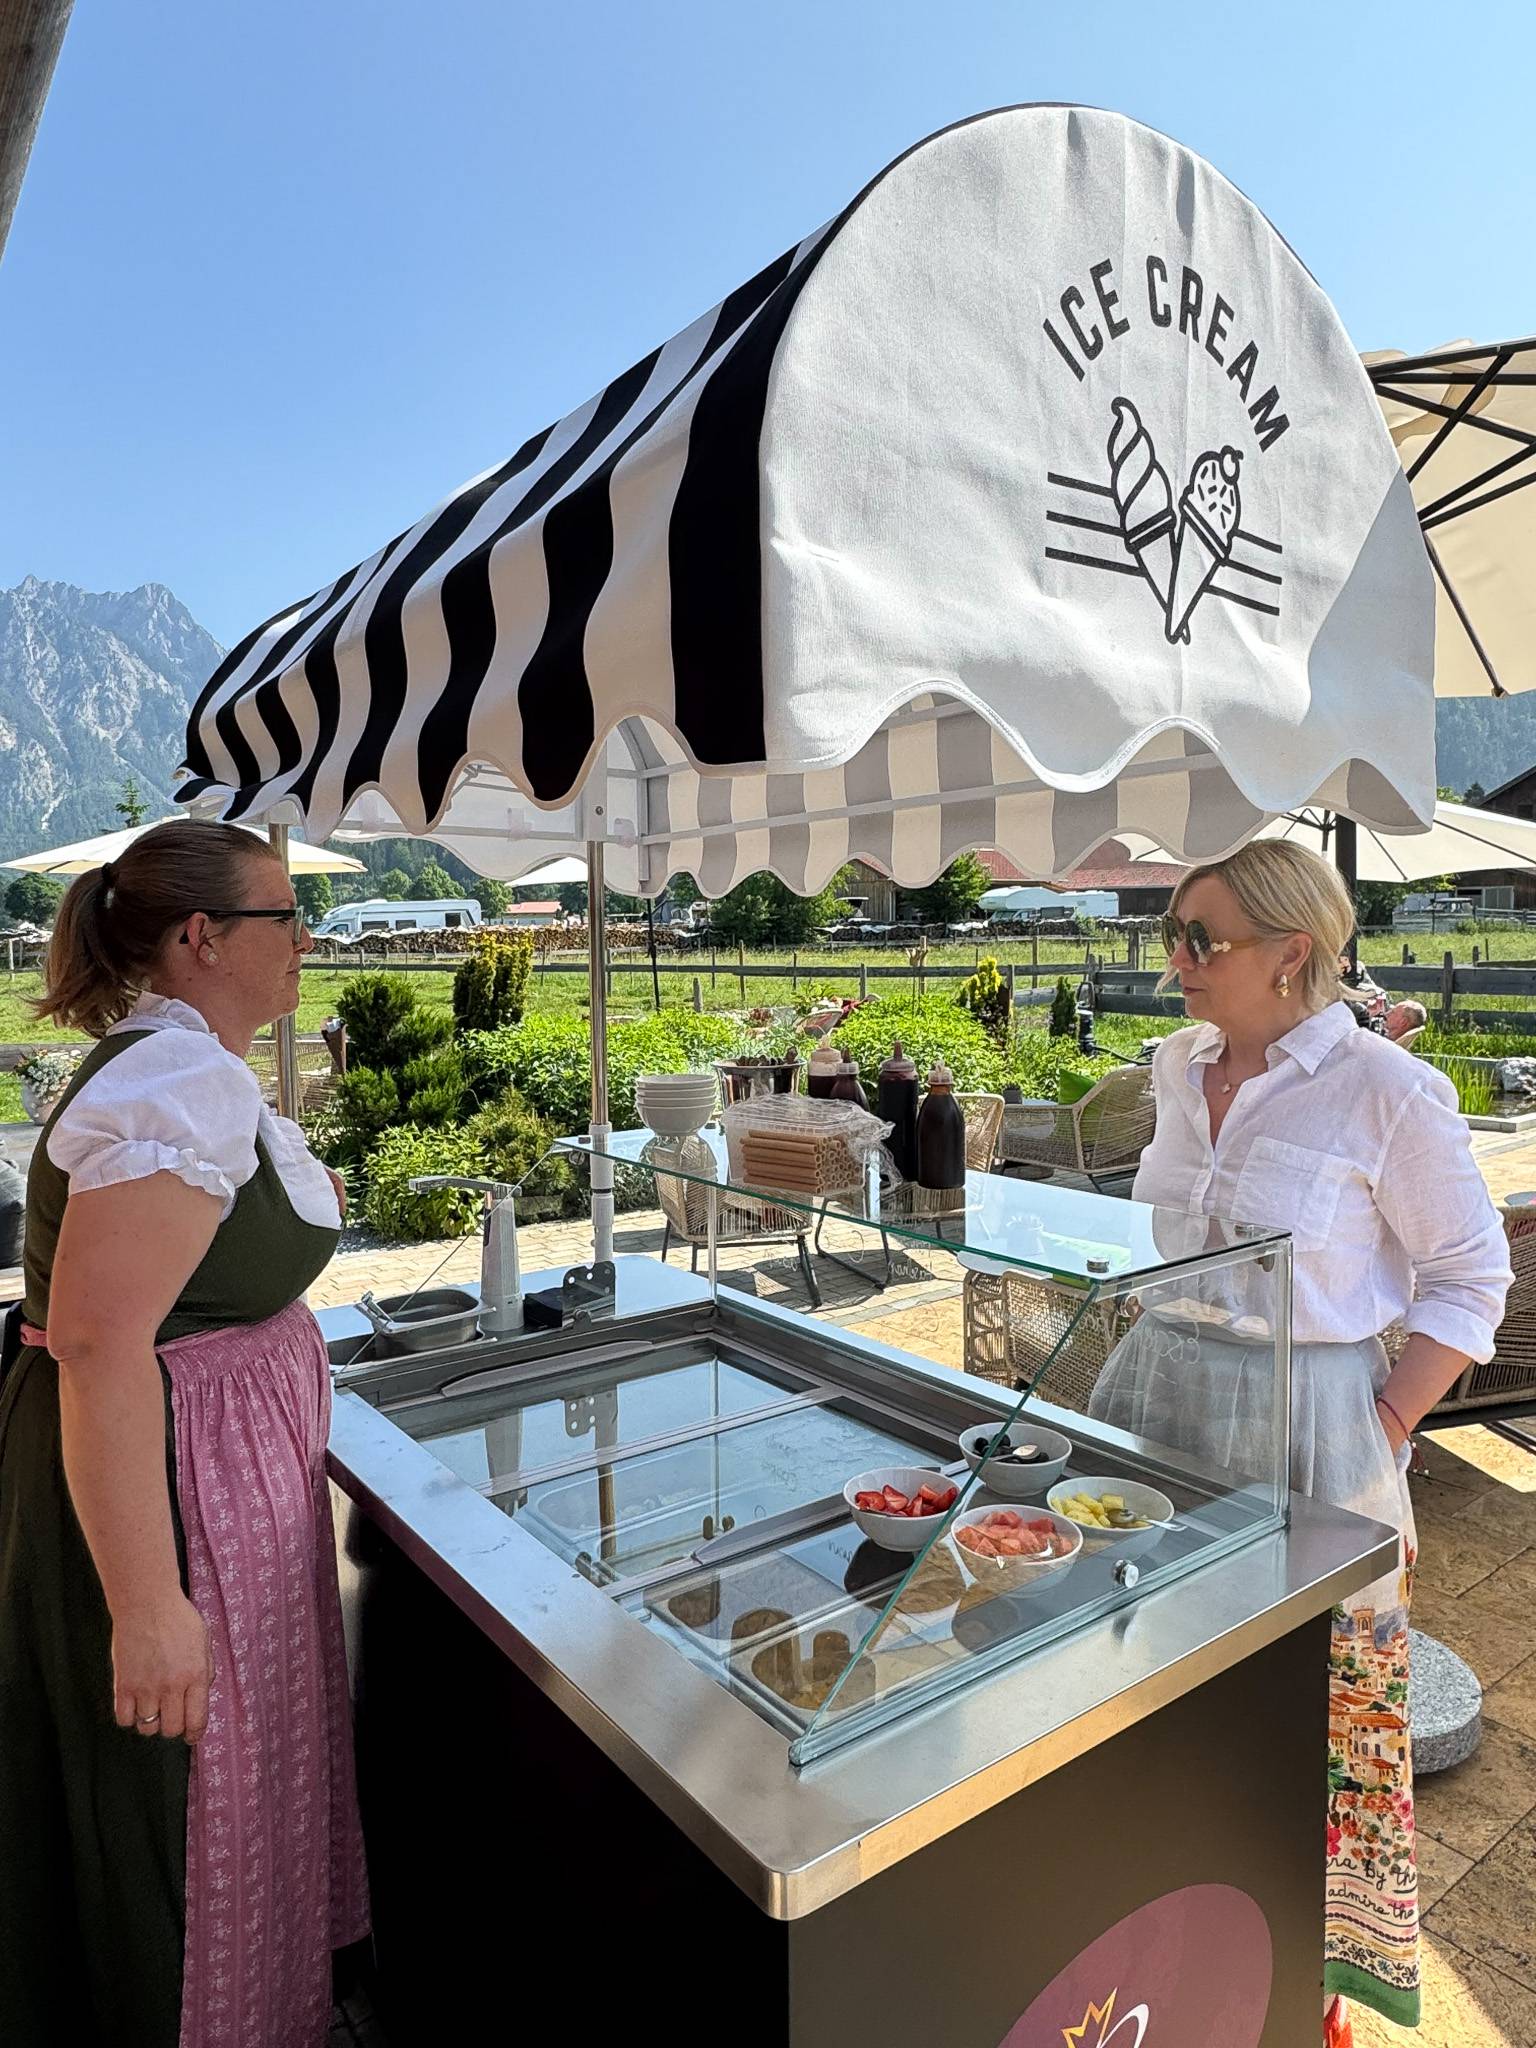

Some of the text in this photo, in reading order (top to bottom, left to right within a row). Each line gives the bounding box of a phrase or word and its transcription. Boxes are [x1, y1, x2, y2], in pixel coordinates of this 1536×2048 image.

[1043, 255, 1290, 453] ICE CREAM
[1327, 1882, 1415, 1920] admire the
